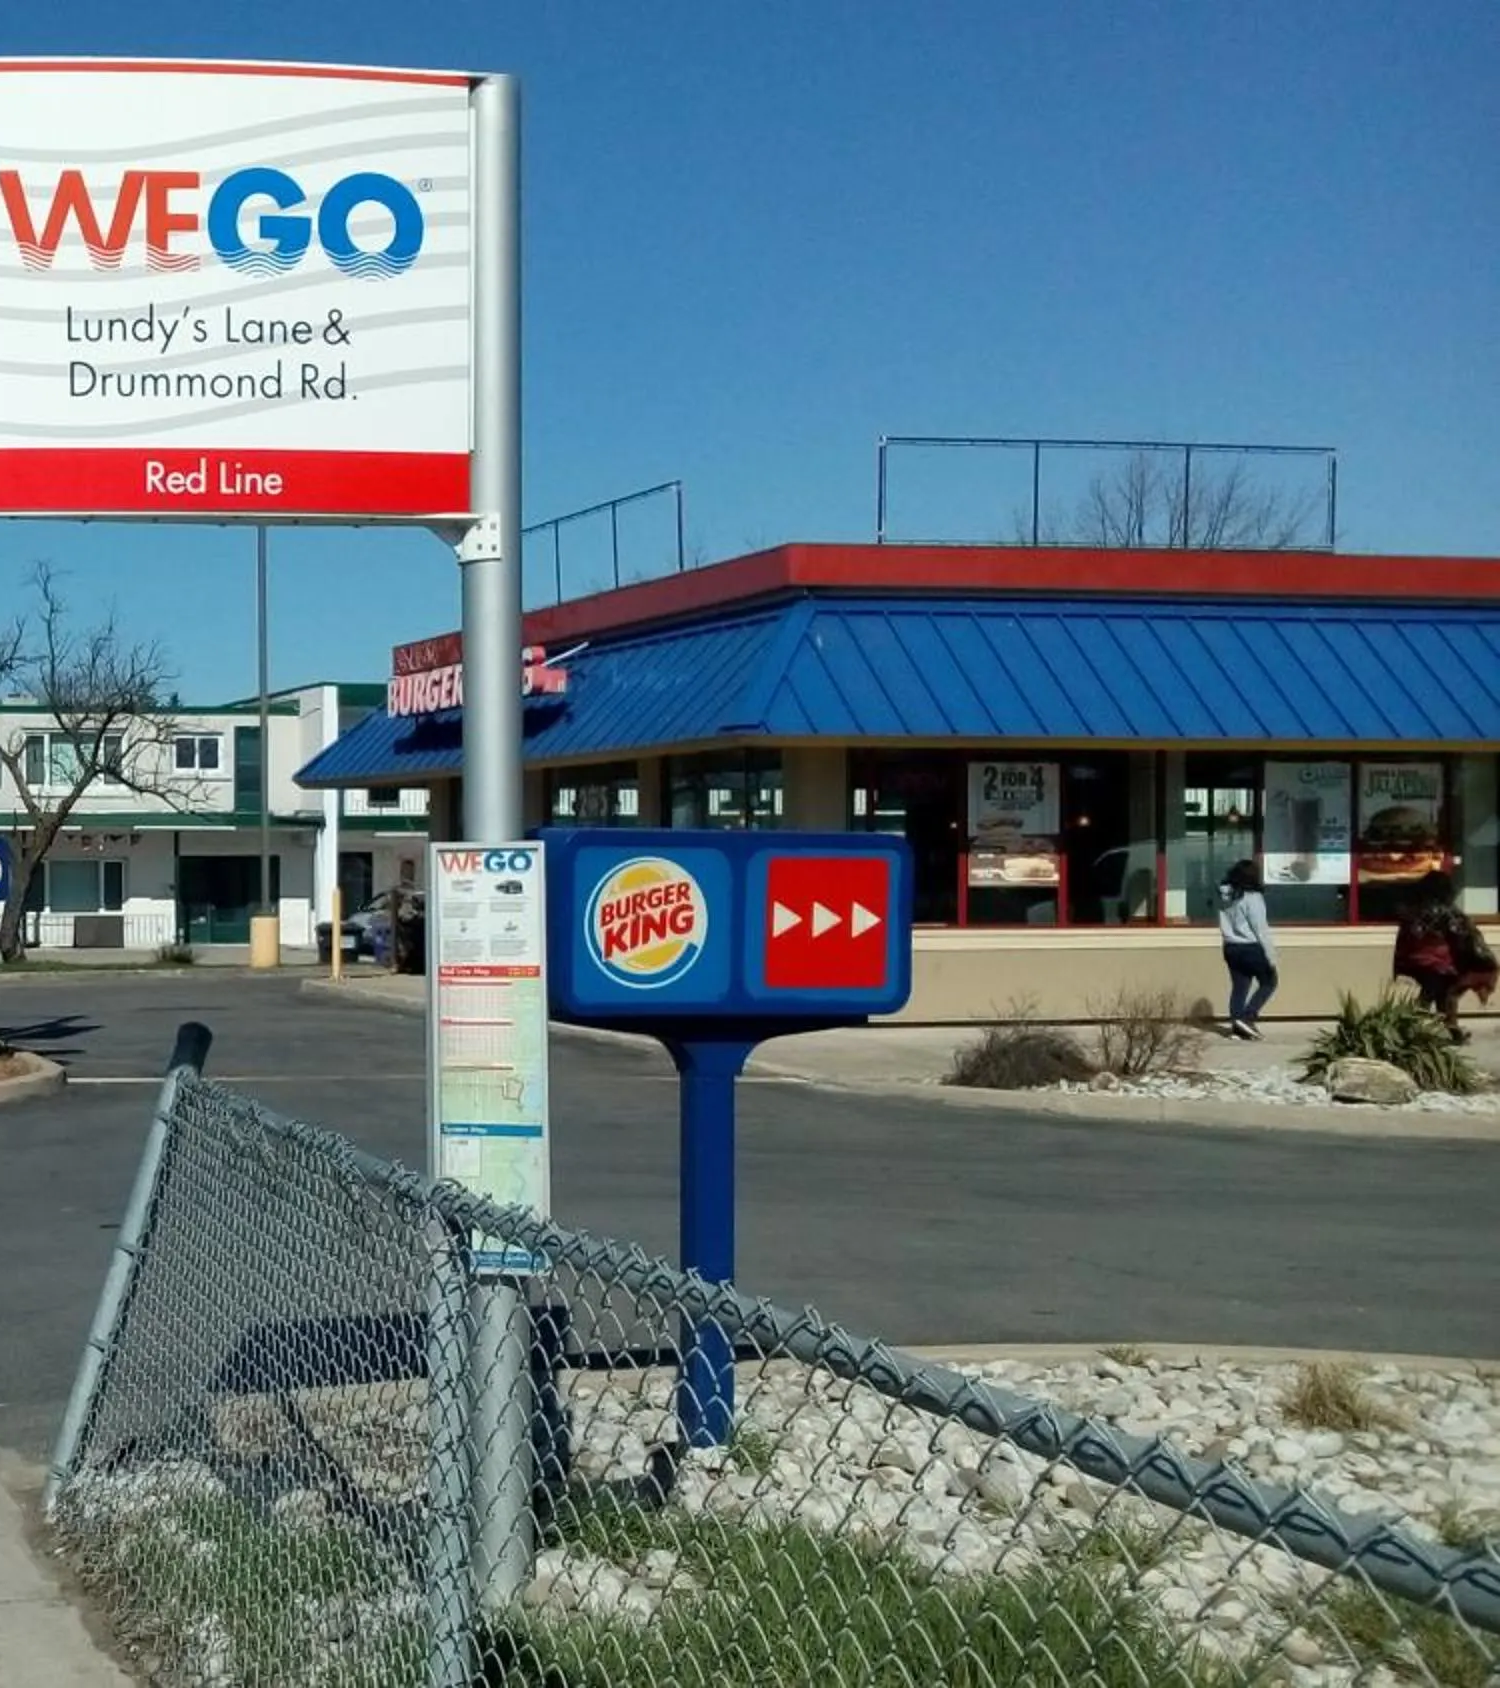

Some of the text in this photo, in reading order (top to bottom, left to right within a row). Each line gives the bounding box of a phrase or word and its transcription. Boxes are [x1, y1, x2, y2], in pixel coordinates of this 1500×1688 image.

[67, 303, 351, 354] Lundy's Lane &
[69, 360, 357, 400] Drummond Rd.
[146, 457, 283, 495] Red Line
[600, 881, 691, 927] BURGER
[604, 904, 694, 959] KING
